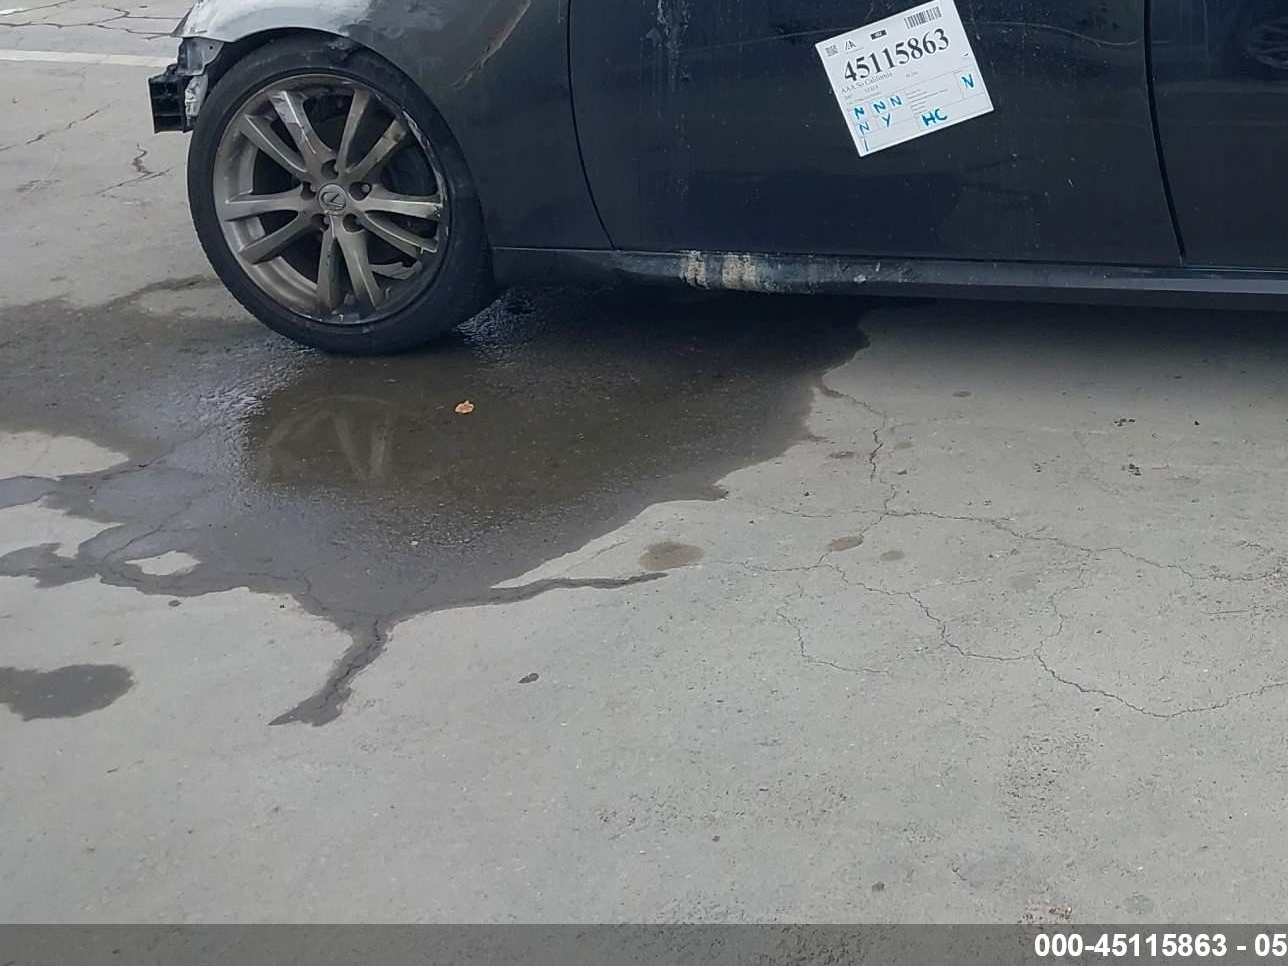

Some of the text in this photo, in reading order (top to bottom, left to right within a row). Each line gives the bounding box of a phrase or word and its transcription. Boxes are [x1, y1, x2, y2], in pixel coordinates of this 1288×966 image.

[843, 28, 950, 82] 45115863
[864, 72, 893, 85] California
[961, 73, 974, 89] N
[854, 107, 865, 120] N
[873, 101, 886, 114] N
[890, 95, 903, 107] N
[882, 113, 892, 128] Y
[922, 108, 948, 126] HC
